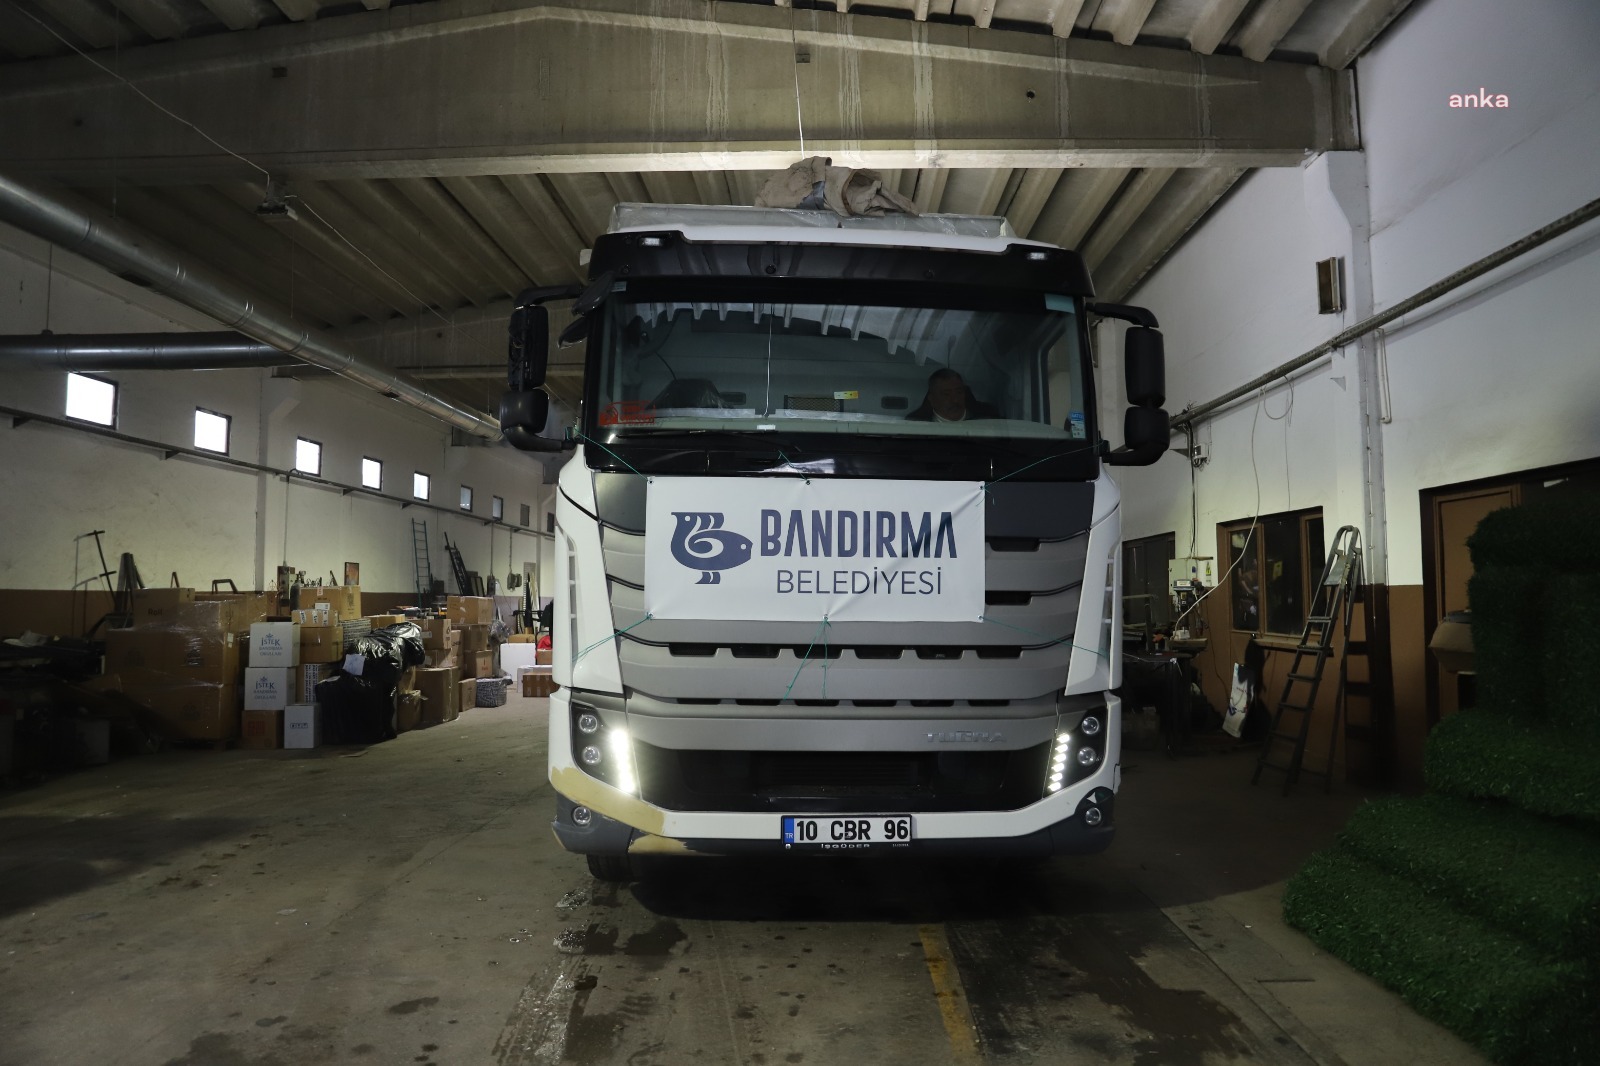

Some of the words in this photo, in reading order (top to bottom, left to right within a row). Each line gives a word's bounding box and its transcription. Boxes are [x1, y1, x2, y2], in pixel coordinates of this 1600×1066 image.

[760, 509, 958, 559] BANDIRMA
[777, 567, 942, 595] BELEDİYESİ
[796, 820, 818, 841] 10
[831, 820, 871, 841] CBR
[884, 819, 909, 840] 96
